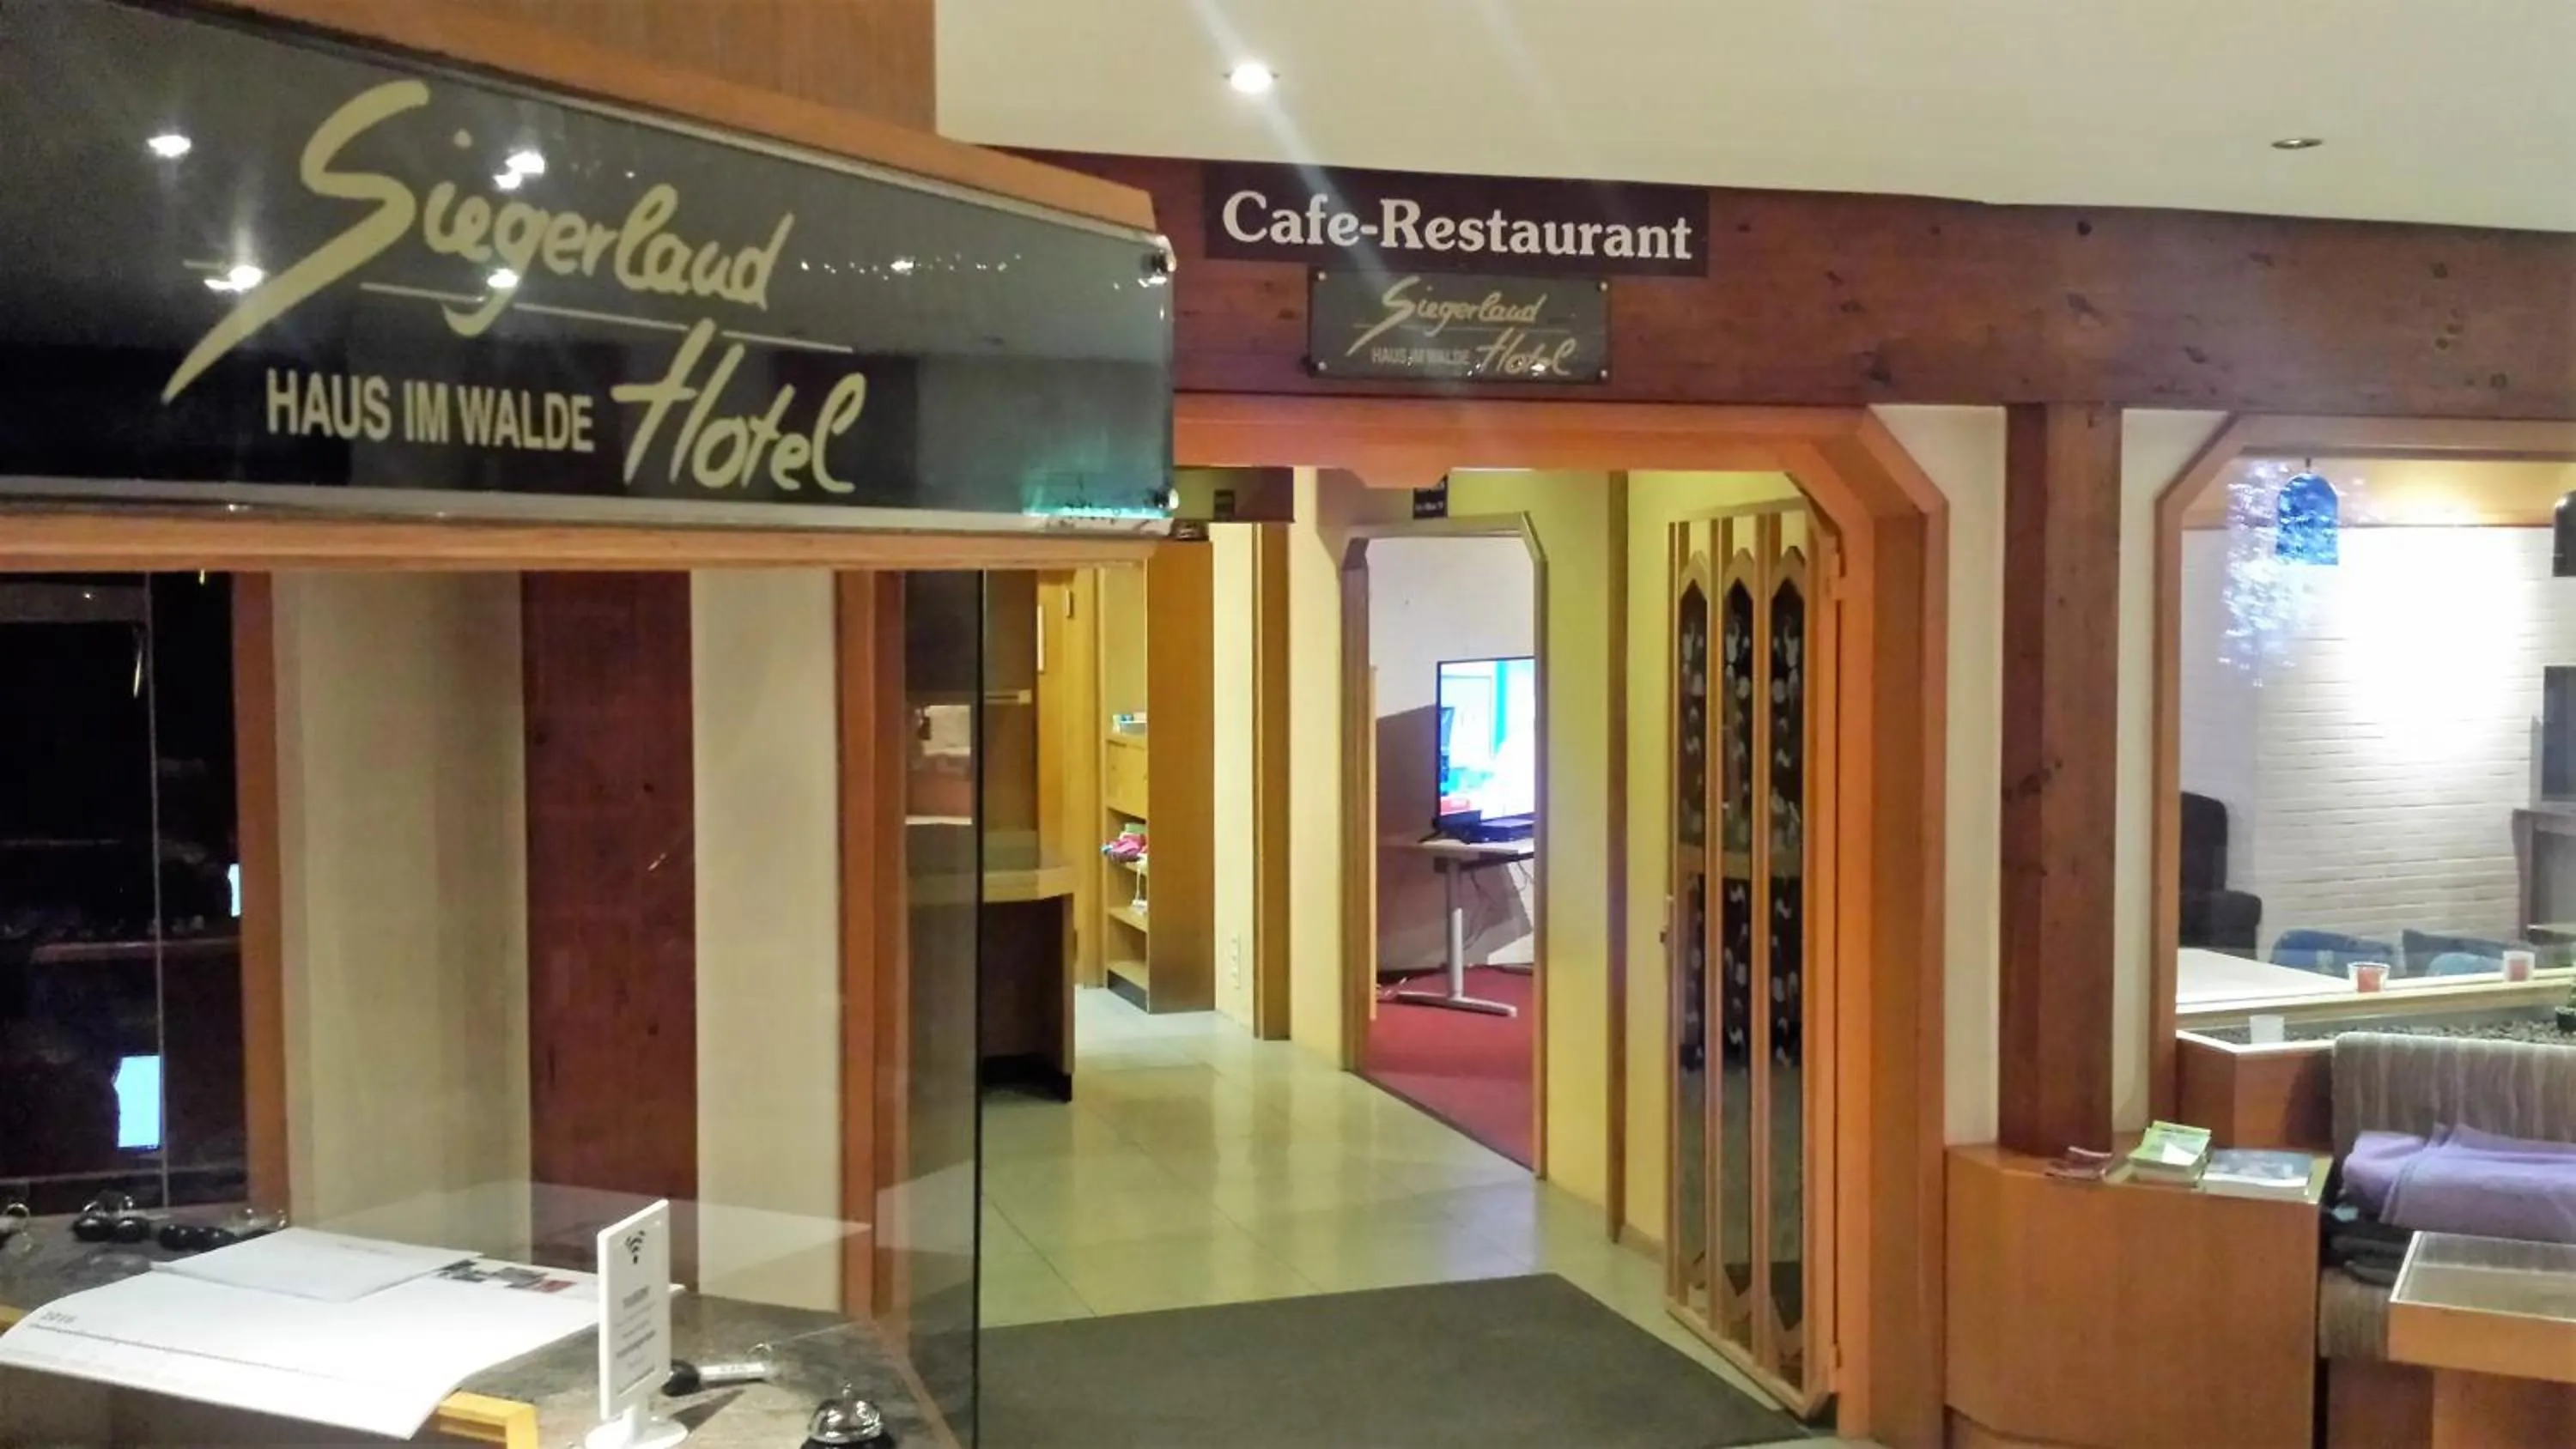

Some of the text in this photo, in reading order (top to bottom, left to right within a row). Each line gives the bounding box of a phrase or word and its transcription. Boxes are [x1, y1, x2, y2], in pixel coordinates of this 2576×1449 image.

[161, 78, 795, 405] Siegerland
[1222, 190, 1693, 260] Cafe-Restaurant
[1345, 275, 1547, 357] Siegerland
[1371, 347, 1406, 365] HAUS
[266, 318, 866, 494] HAUS IM WALDE Hotel
